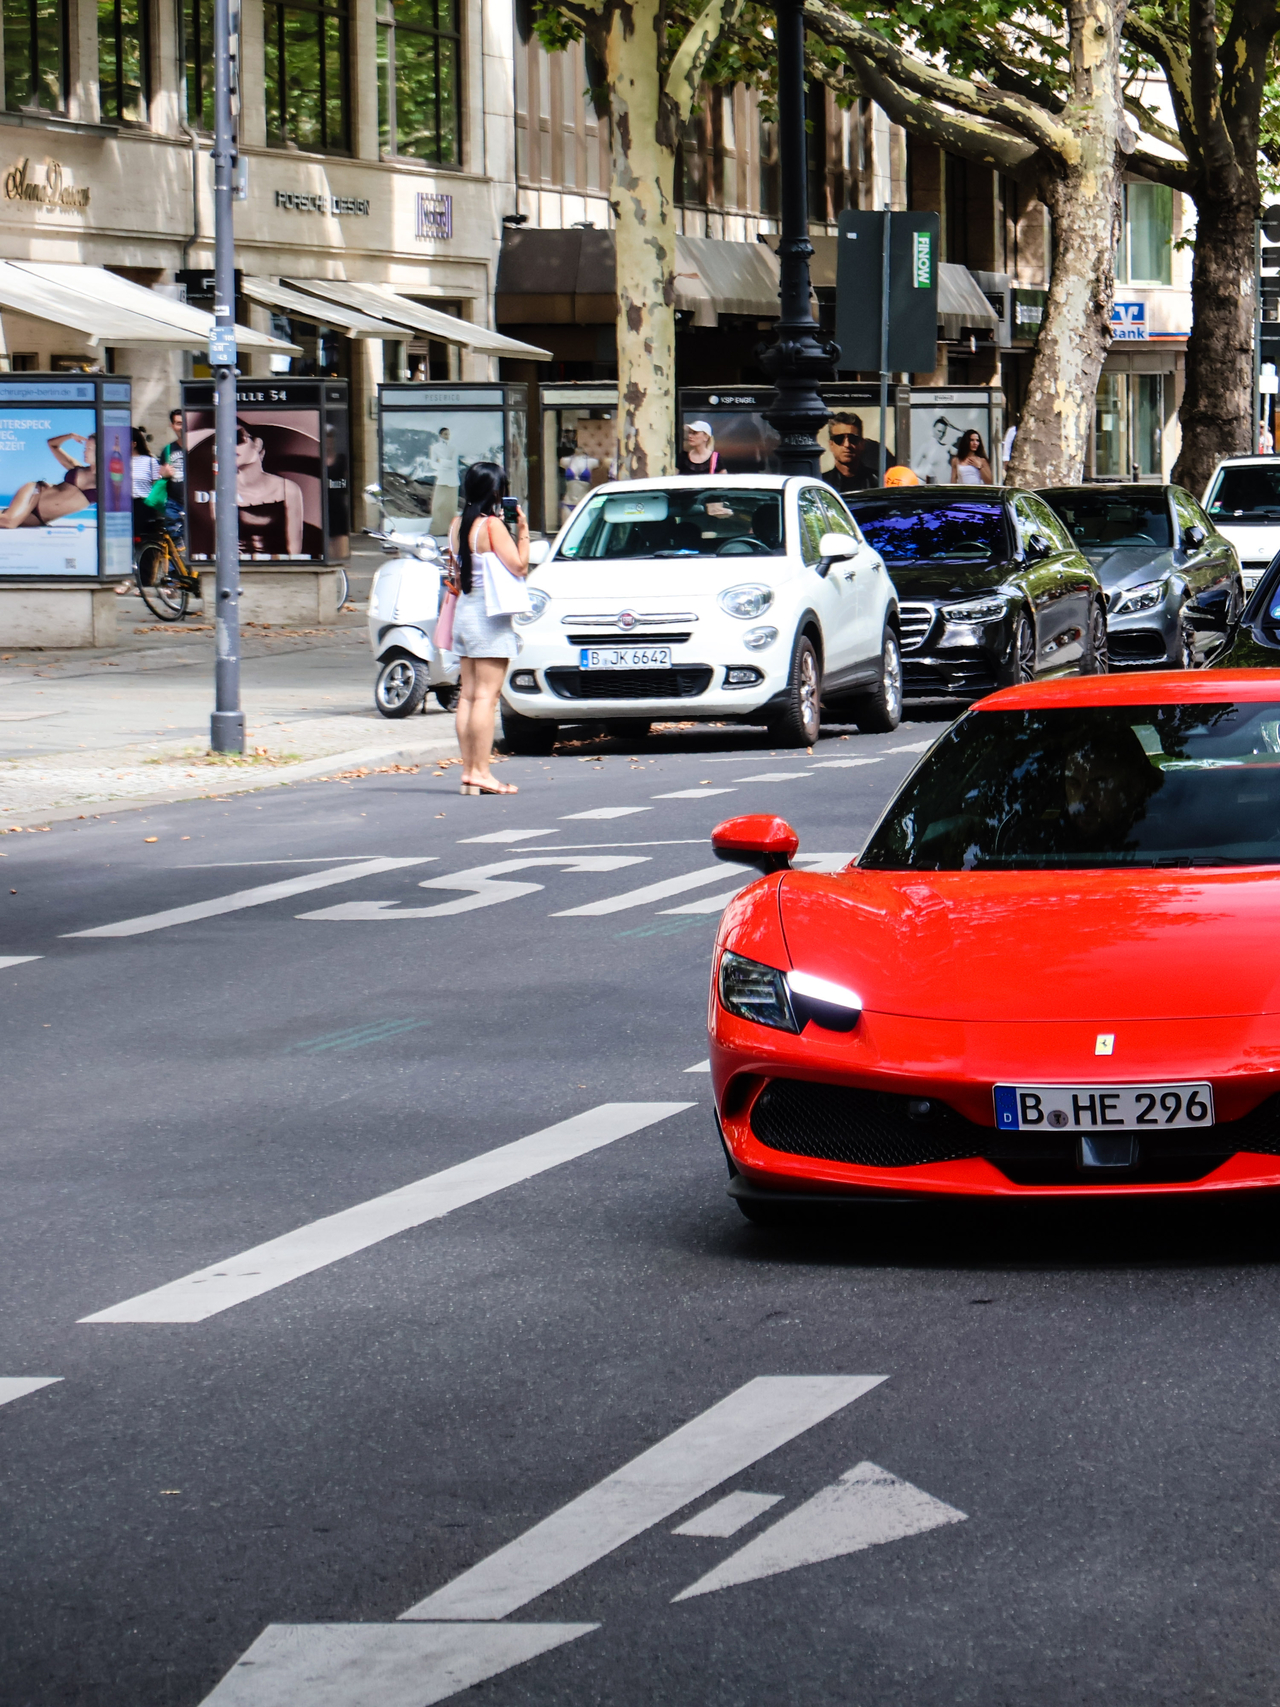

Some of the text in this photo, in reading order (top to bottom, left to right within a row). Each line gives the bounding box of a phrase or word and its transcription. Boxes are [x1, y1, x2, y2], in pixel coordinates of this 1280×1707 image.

[275, 190, 371, 216] PORSCHE DESIGN
[918, 237, 930, 284] FINOW
[236, 392, 264, 401] ILLE
[591, 651, 600, 666] B
[610, 650, 628, 665] JK
[633, 650, 668, 665] 6642
[1003, 1091, 1208, 1125] D B HE 296
